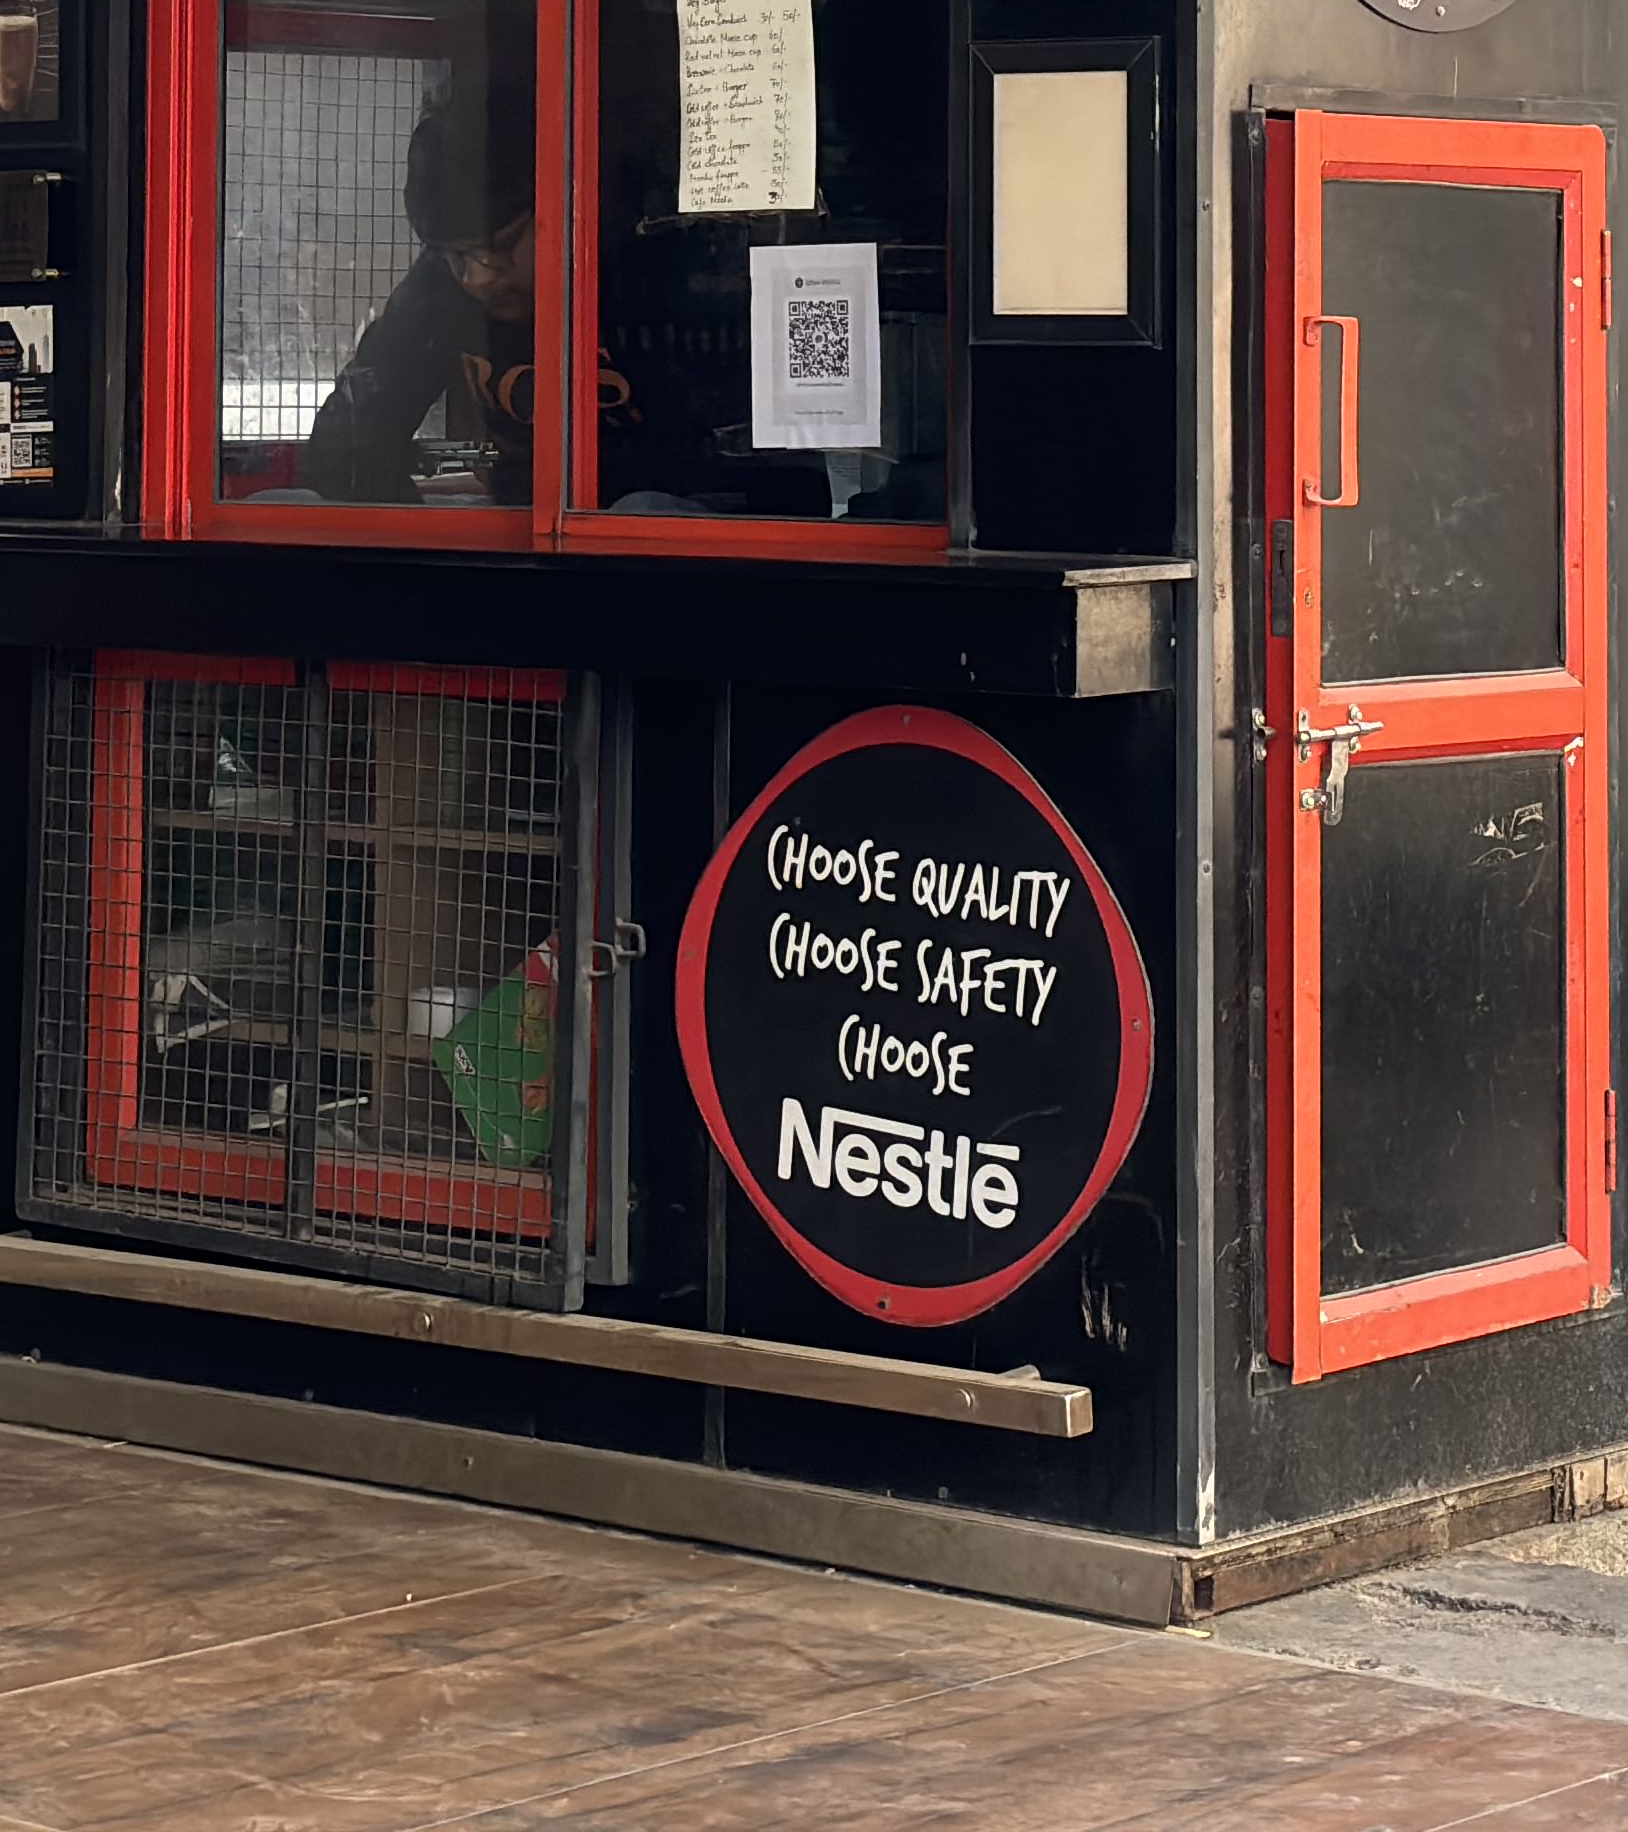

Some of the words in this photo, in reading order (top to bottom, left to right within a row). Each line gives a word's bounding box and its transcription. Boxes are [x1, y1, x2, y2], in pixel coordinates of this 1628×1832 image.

[767, 824, 900, 904] CHOOSE
[912, 857, 1071, 938] QUALITY
[769, 912, 902, 993] CHOOSE
[916, 938, 1057, 1026] SAFETY
[838, 1014, 974, 1096] CHOOSE
